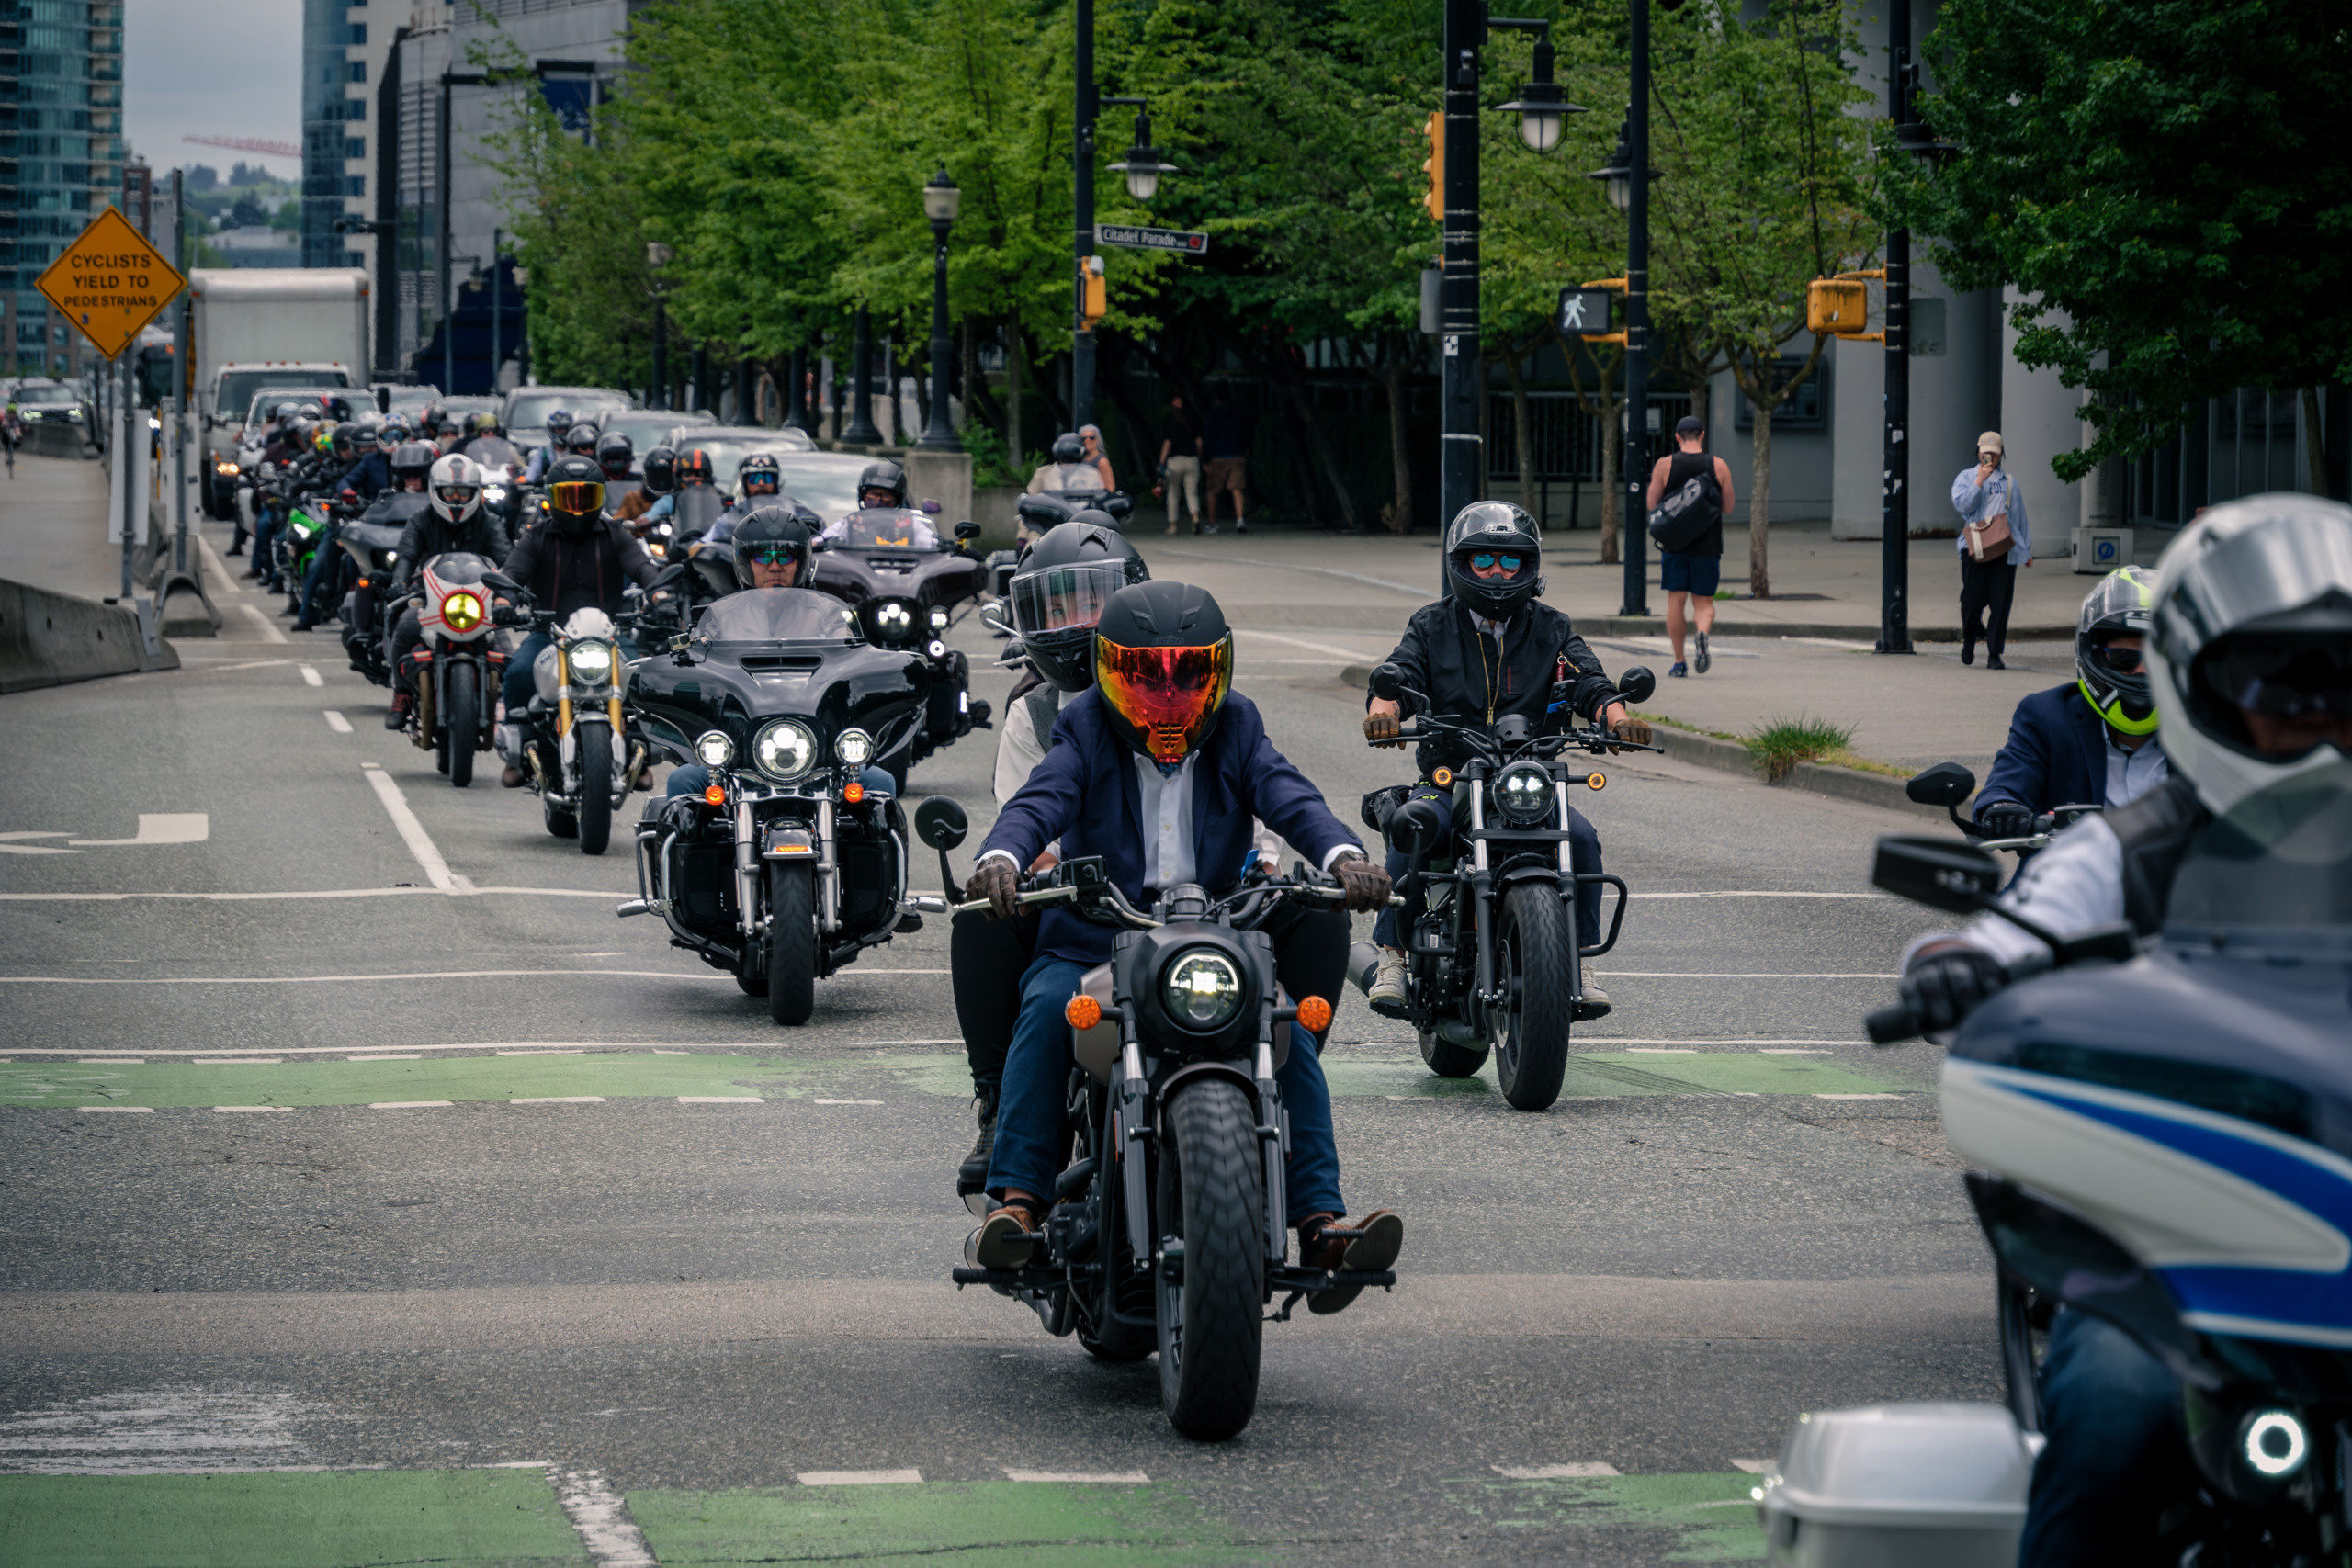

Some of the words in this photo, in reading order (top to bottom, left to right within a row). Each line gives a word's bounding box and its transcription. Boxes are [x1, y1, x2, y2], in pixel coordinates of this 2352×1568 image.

[1103, 228, 1139, 243] Citadel
[1140, 231, 1176, 246] Parade
[72, 254, 151, 268] CYCLISTS
[74, 275, 119, 288] YIELD
[128, 275, 149, 288] TO
[63, 295, 157, 308] PEDESTRIANS
